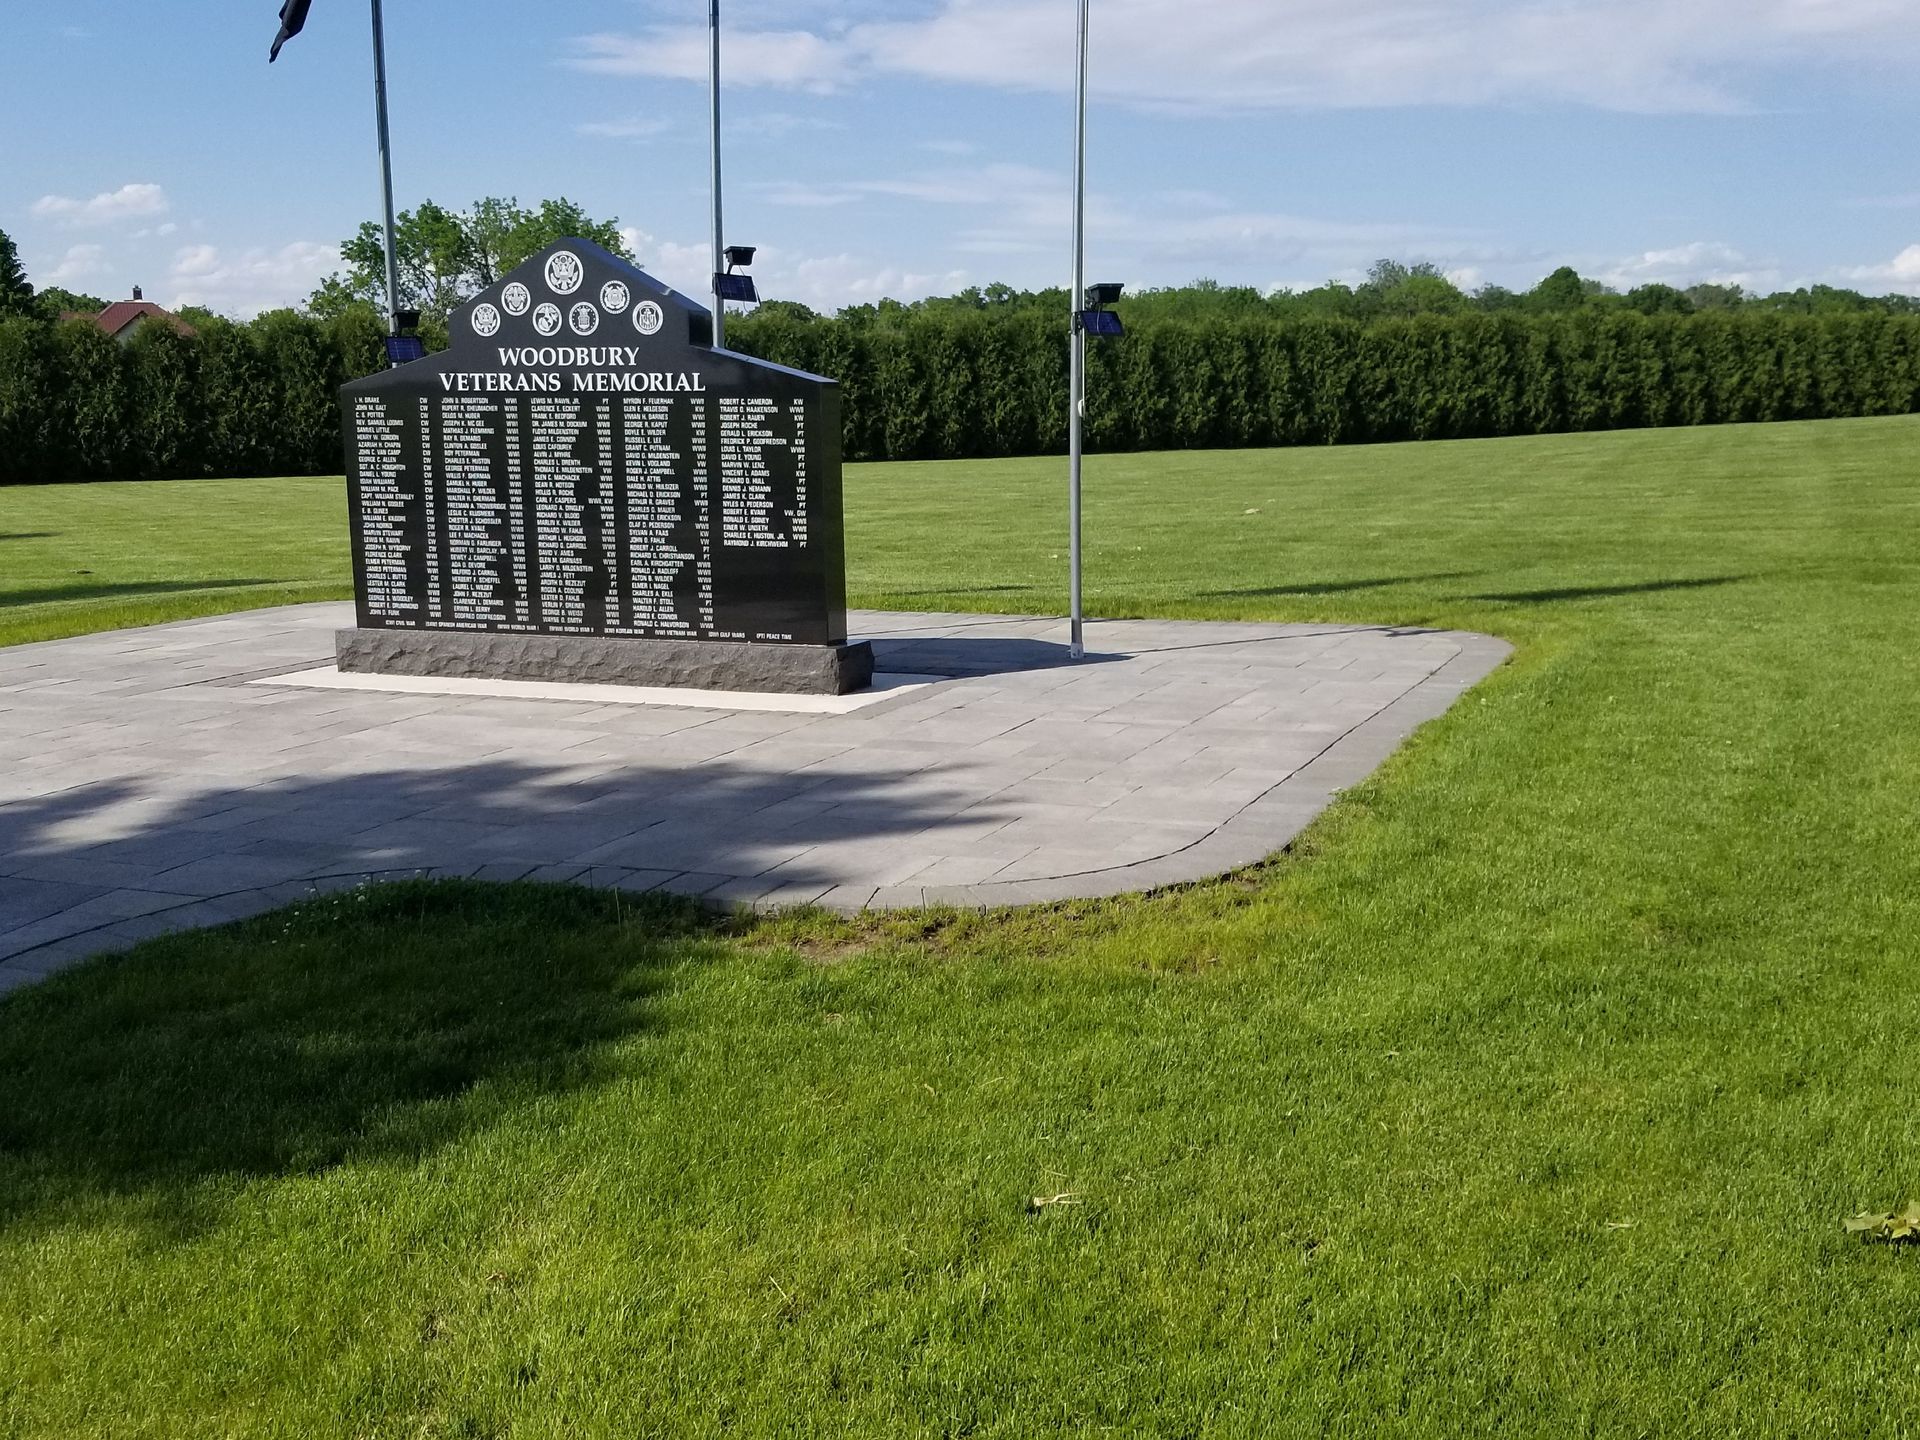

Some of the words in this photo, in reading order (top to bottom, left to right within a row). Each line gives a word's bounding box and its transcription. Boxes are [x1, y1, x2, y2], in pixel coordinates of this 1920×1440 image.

[498, 346, 639, 367] WOODBURY
[438, 372, 561, 392] VETERANS
[572, 372, 706, 392] MEMORIAL
